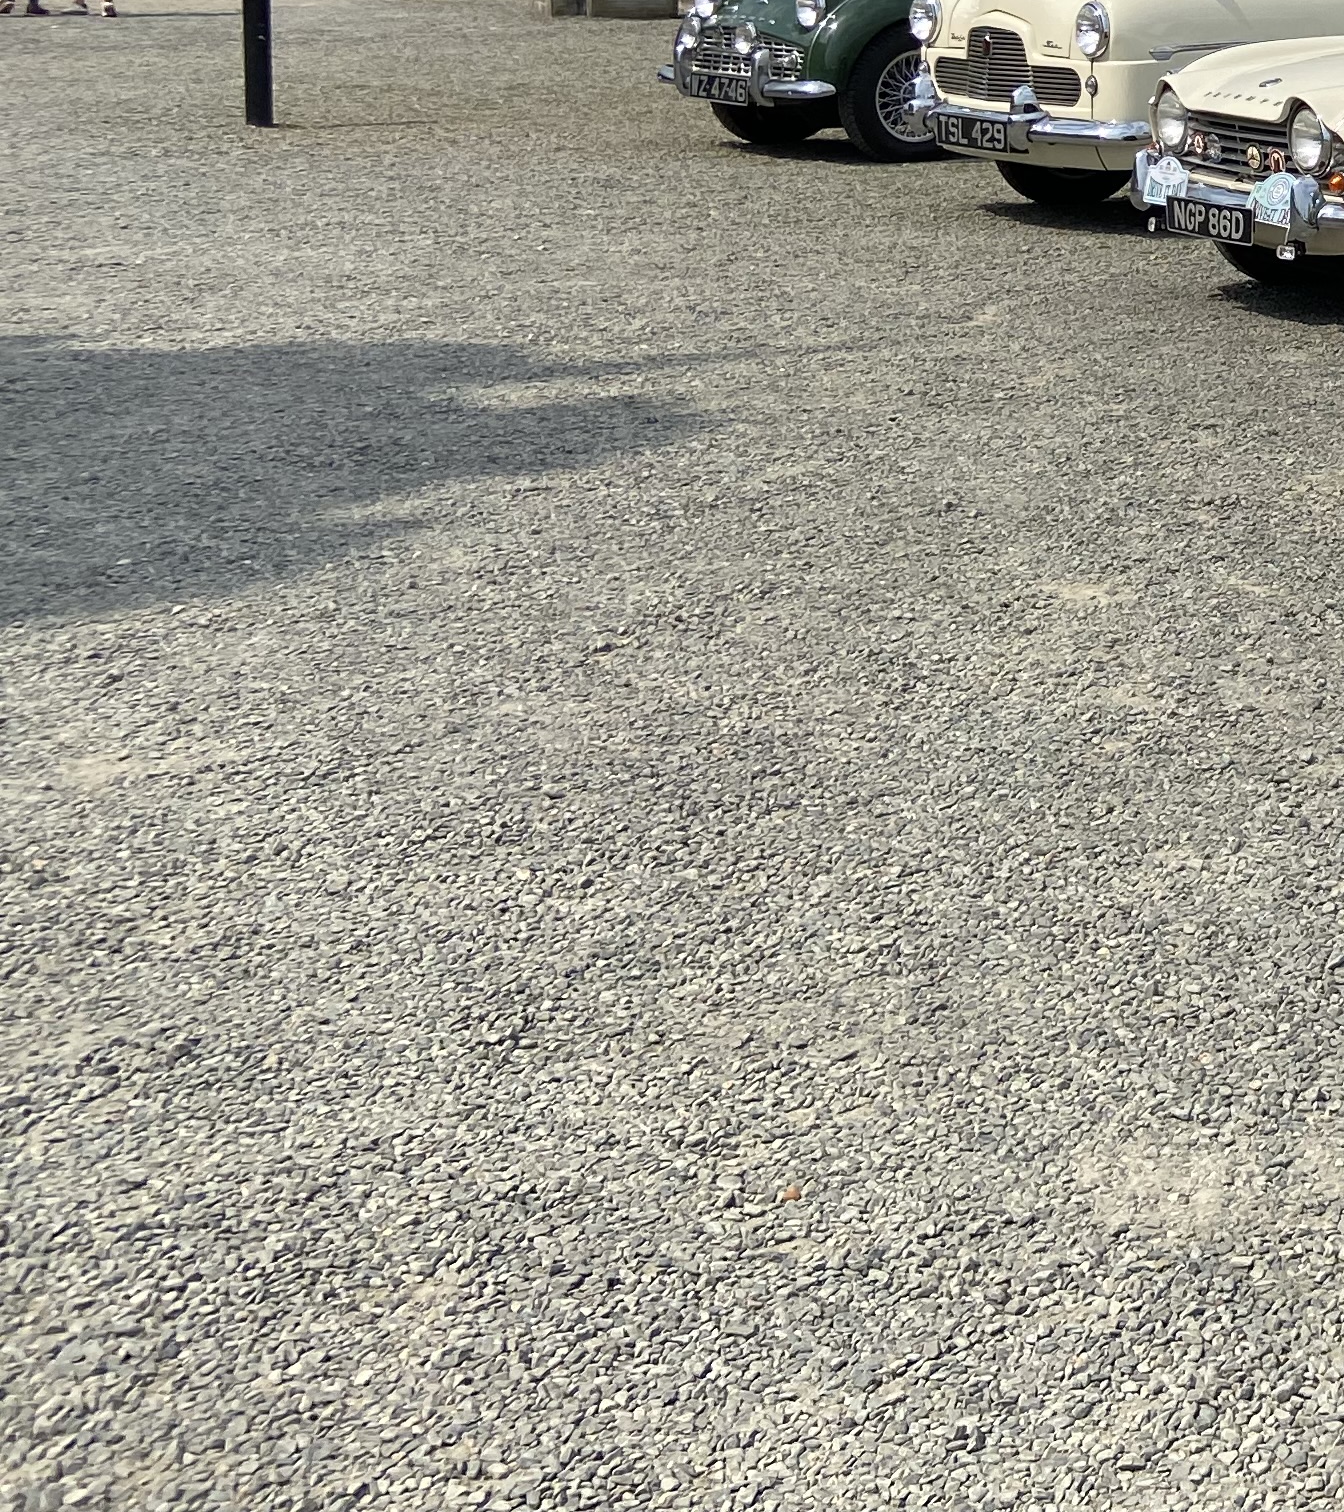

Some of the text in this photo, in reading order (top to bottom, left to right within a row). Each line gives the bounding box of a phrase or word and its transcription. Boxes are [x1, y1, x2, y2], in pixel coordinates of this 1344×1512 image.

[710, 77, 746, 102] 4746
[938, 115, 1005, 150] TSL 429
[1173, 200, 1244, 240] NGP 86D
